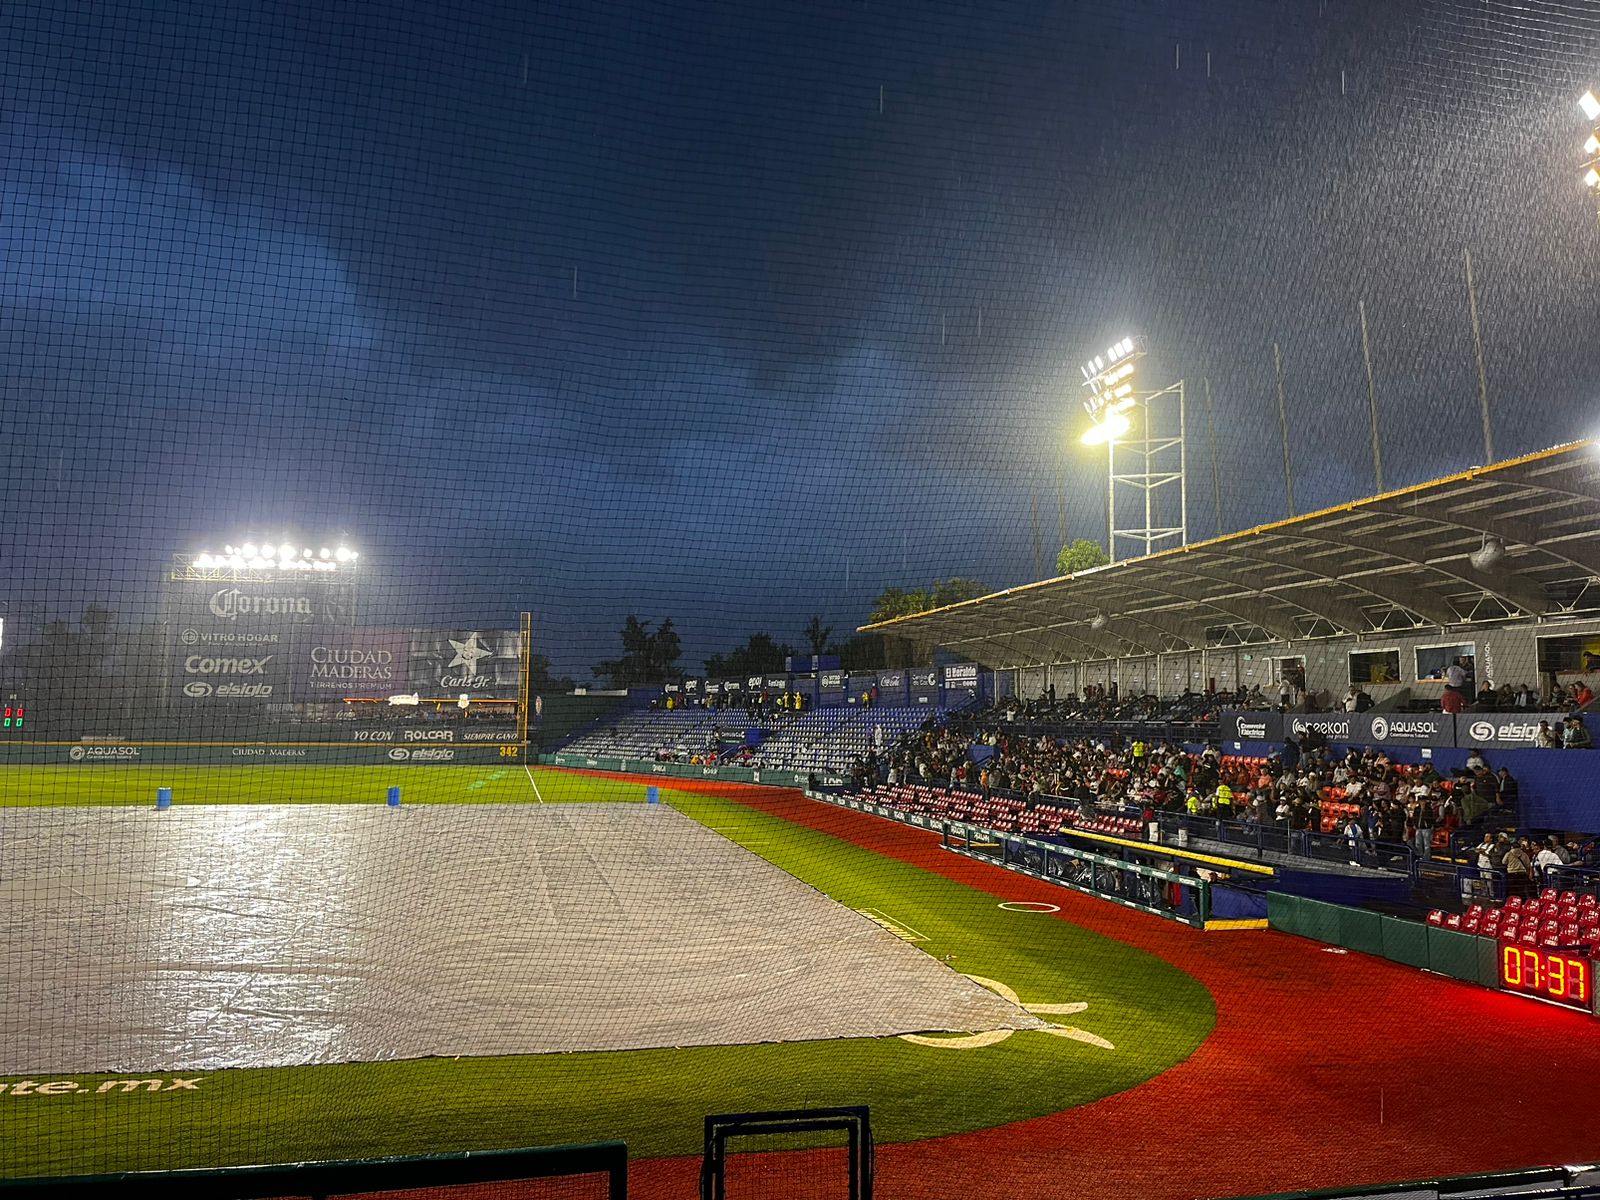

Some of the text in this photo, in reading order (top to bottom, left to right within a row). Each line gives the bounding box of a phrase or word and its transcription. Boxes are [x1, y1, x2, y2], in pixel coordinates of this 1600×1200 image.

[209, 588, 313, 620] Corona
[200, 632, 278, 643] VITRO HOGAR
[311, 646, 393, 664] CIUDAD
[311, 663, 392, 679] MADERAS
[1390, 721, 1437, 733] AQUASOL
[354, 731, 368, 741] YO
[370, 730, 394, 741] CON
[404, 730, 453, 742] ROLCAR
[463, 732, 495, 741] SIEMPRE
[87, 746, 140, 756] AQUASOL
[232, 748, 306, 757] CIUDAD MADERAS
[499, 746, 518, 757] 342
[1503, 946, 1585, 1000] 07:37
[0, 1077, 208, 1096] te.mx
